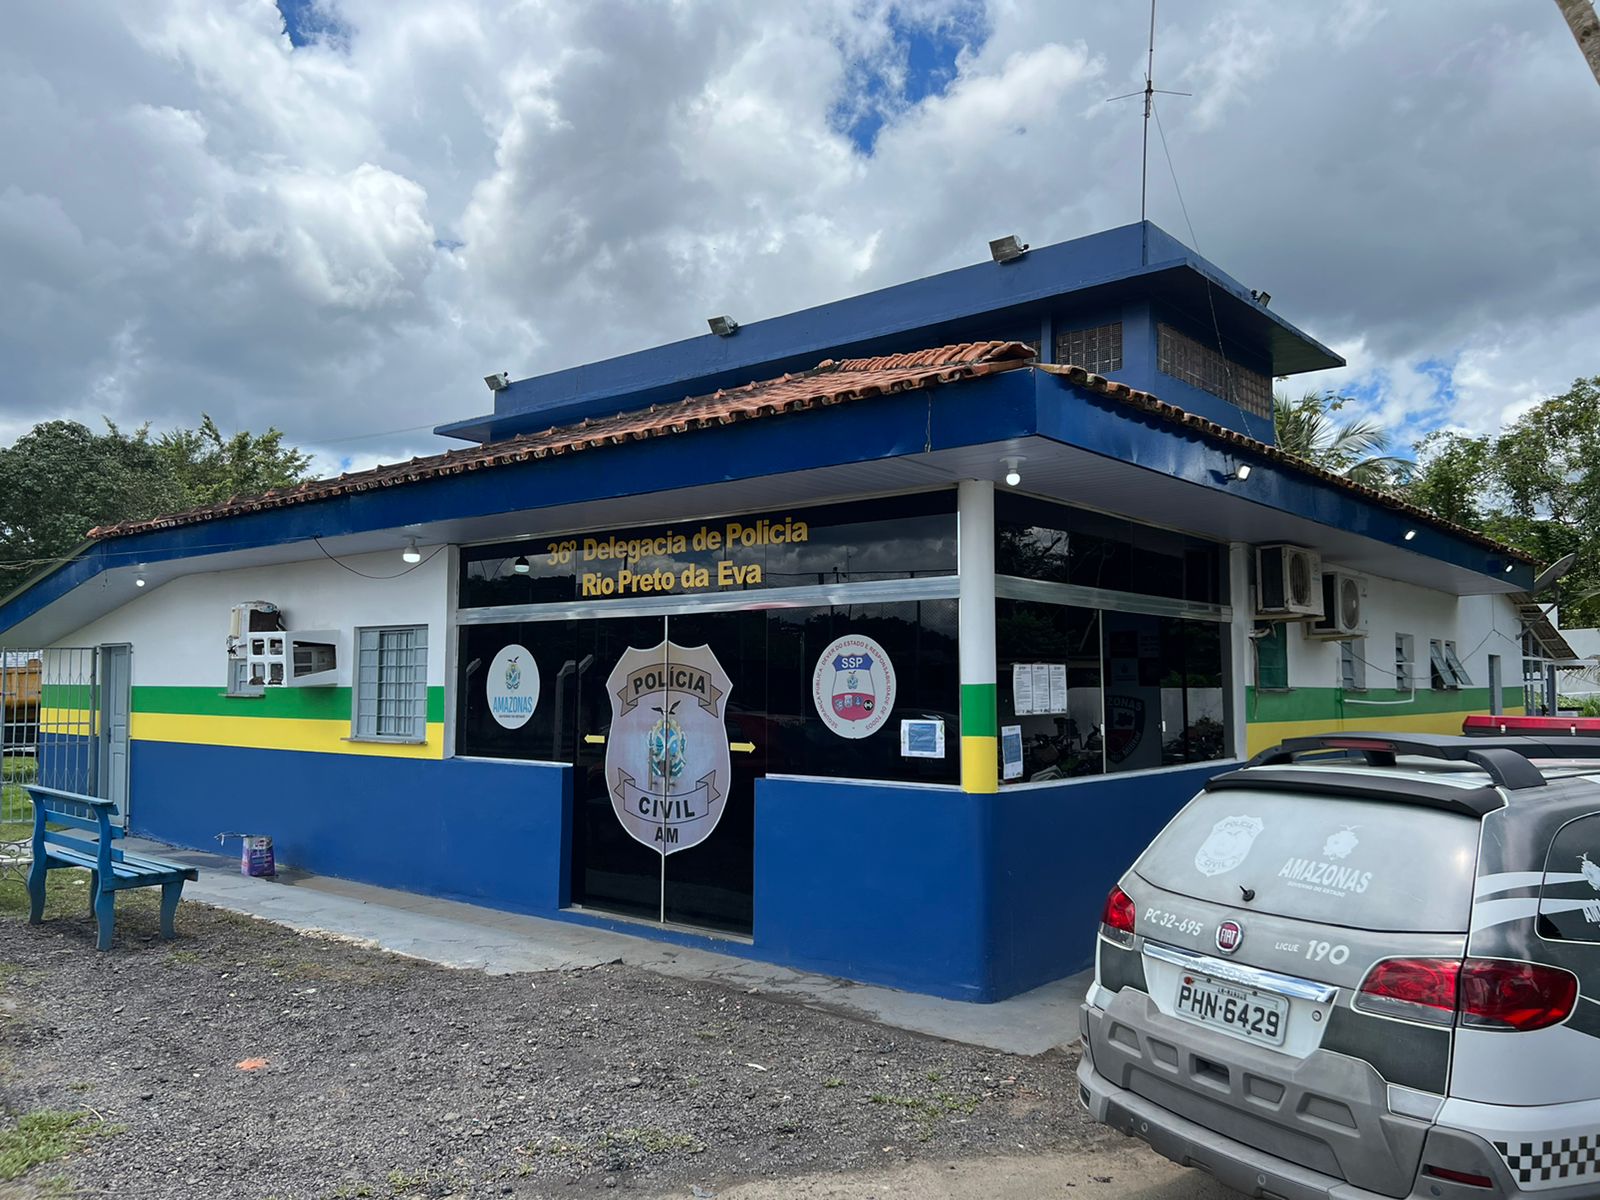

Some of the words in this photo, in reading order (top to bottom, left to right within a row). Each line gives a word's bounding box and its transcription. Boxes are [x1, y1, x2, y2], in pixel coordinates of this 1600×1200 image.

[583, 530, 687, 564] Delegacia
[692, 526, 721, 551] de
[582, 572, 614, 597] Rio
[618, 569, 675, 594] Preto
[681, 562, 709, 588] da
[717, 560, 762, 585] Eva
[843, 640, 865, 648] ESTADO
[841, 657, 863, 669] SSP
[633, 666, 706, 694] POLÍCIA
[493, 696, 533, 713] AMAZONAS
[638, 796, 696, 819] CIVIL
[654, 826, 679, 844] AM
[1278, 857, 1373, 894] AMAZONAS
[1144, 908, 1162, 924] PC
[1161, 914, 1204, 937] 32-695
[1220, 927, 1237, 946] FIAT
[1275, 942, 1299, 953] LIGUE
[1305, 940, 1350, 966] 190
